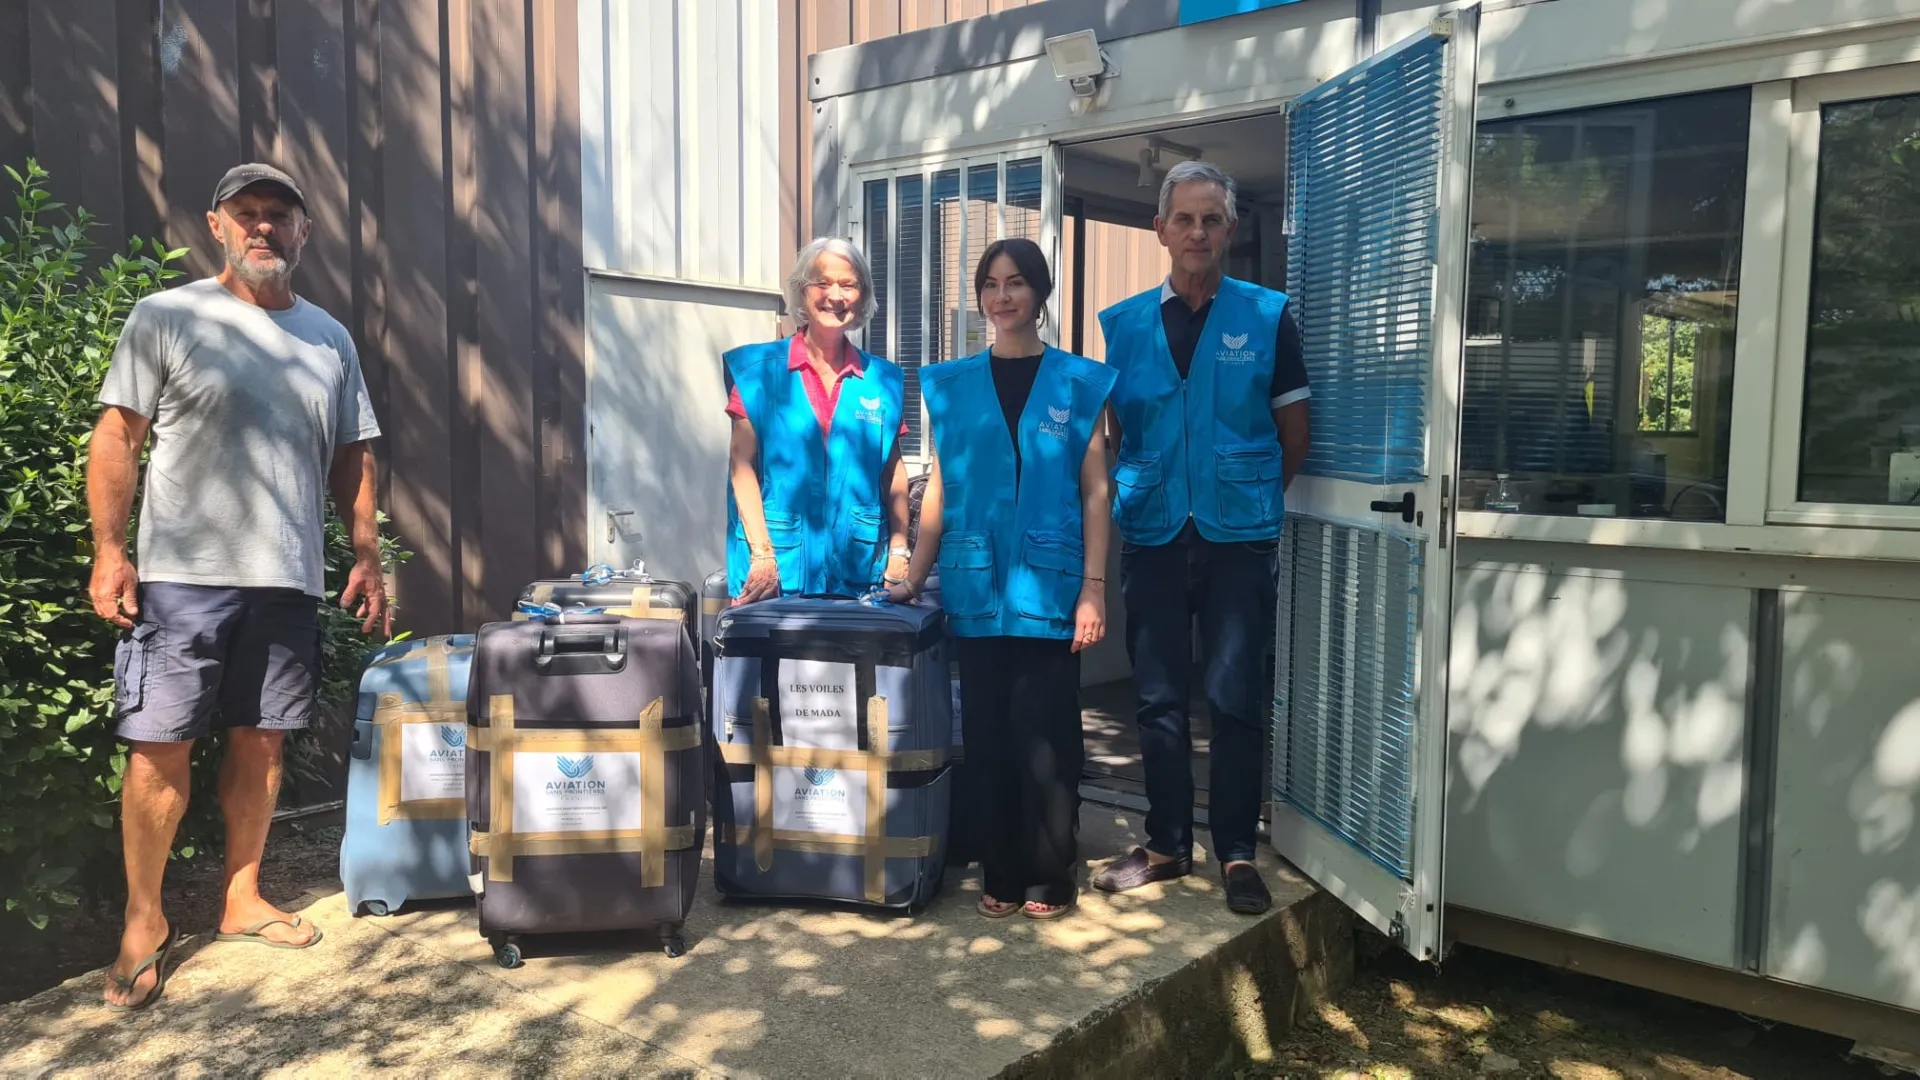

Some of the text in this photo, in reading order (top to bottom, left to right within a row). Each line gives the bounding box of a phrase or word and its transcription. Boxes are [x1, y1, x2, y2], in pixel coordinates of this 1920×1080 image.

[1215, 349, 1255, 358] AVIATION
[790, 684, 845, 694] LES VOILES
[795, 708, 841, 717] DE MADA
[429, 749, 464, 757] AVIAT
[545, 780, 606, 790] AVIATION
[794, 787, 845, 797] AVIATION
